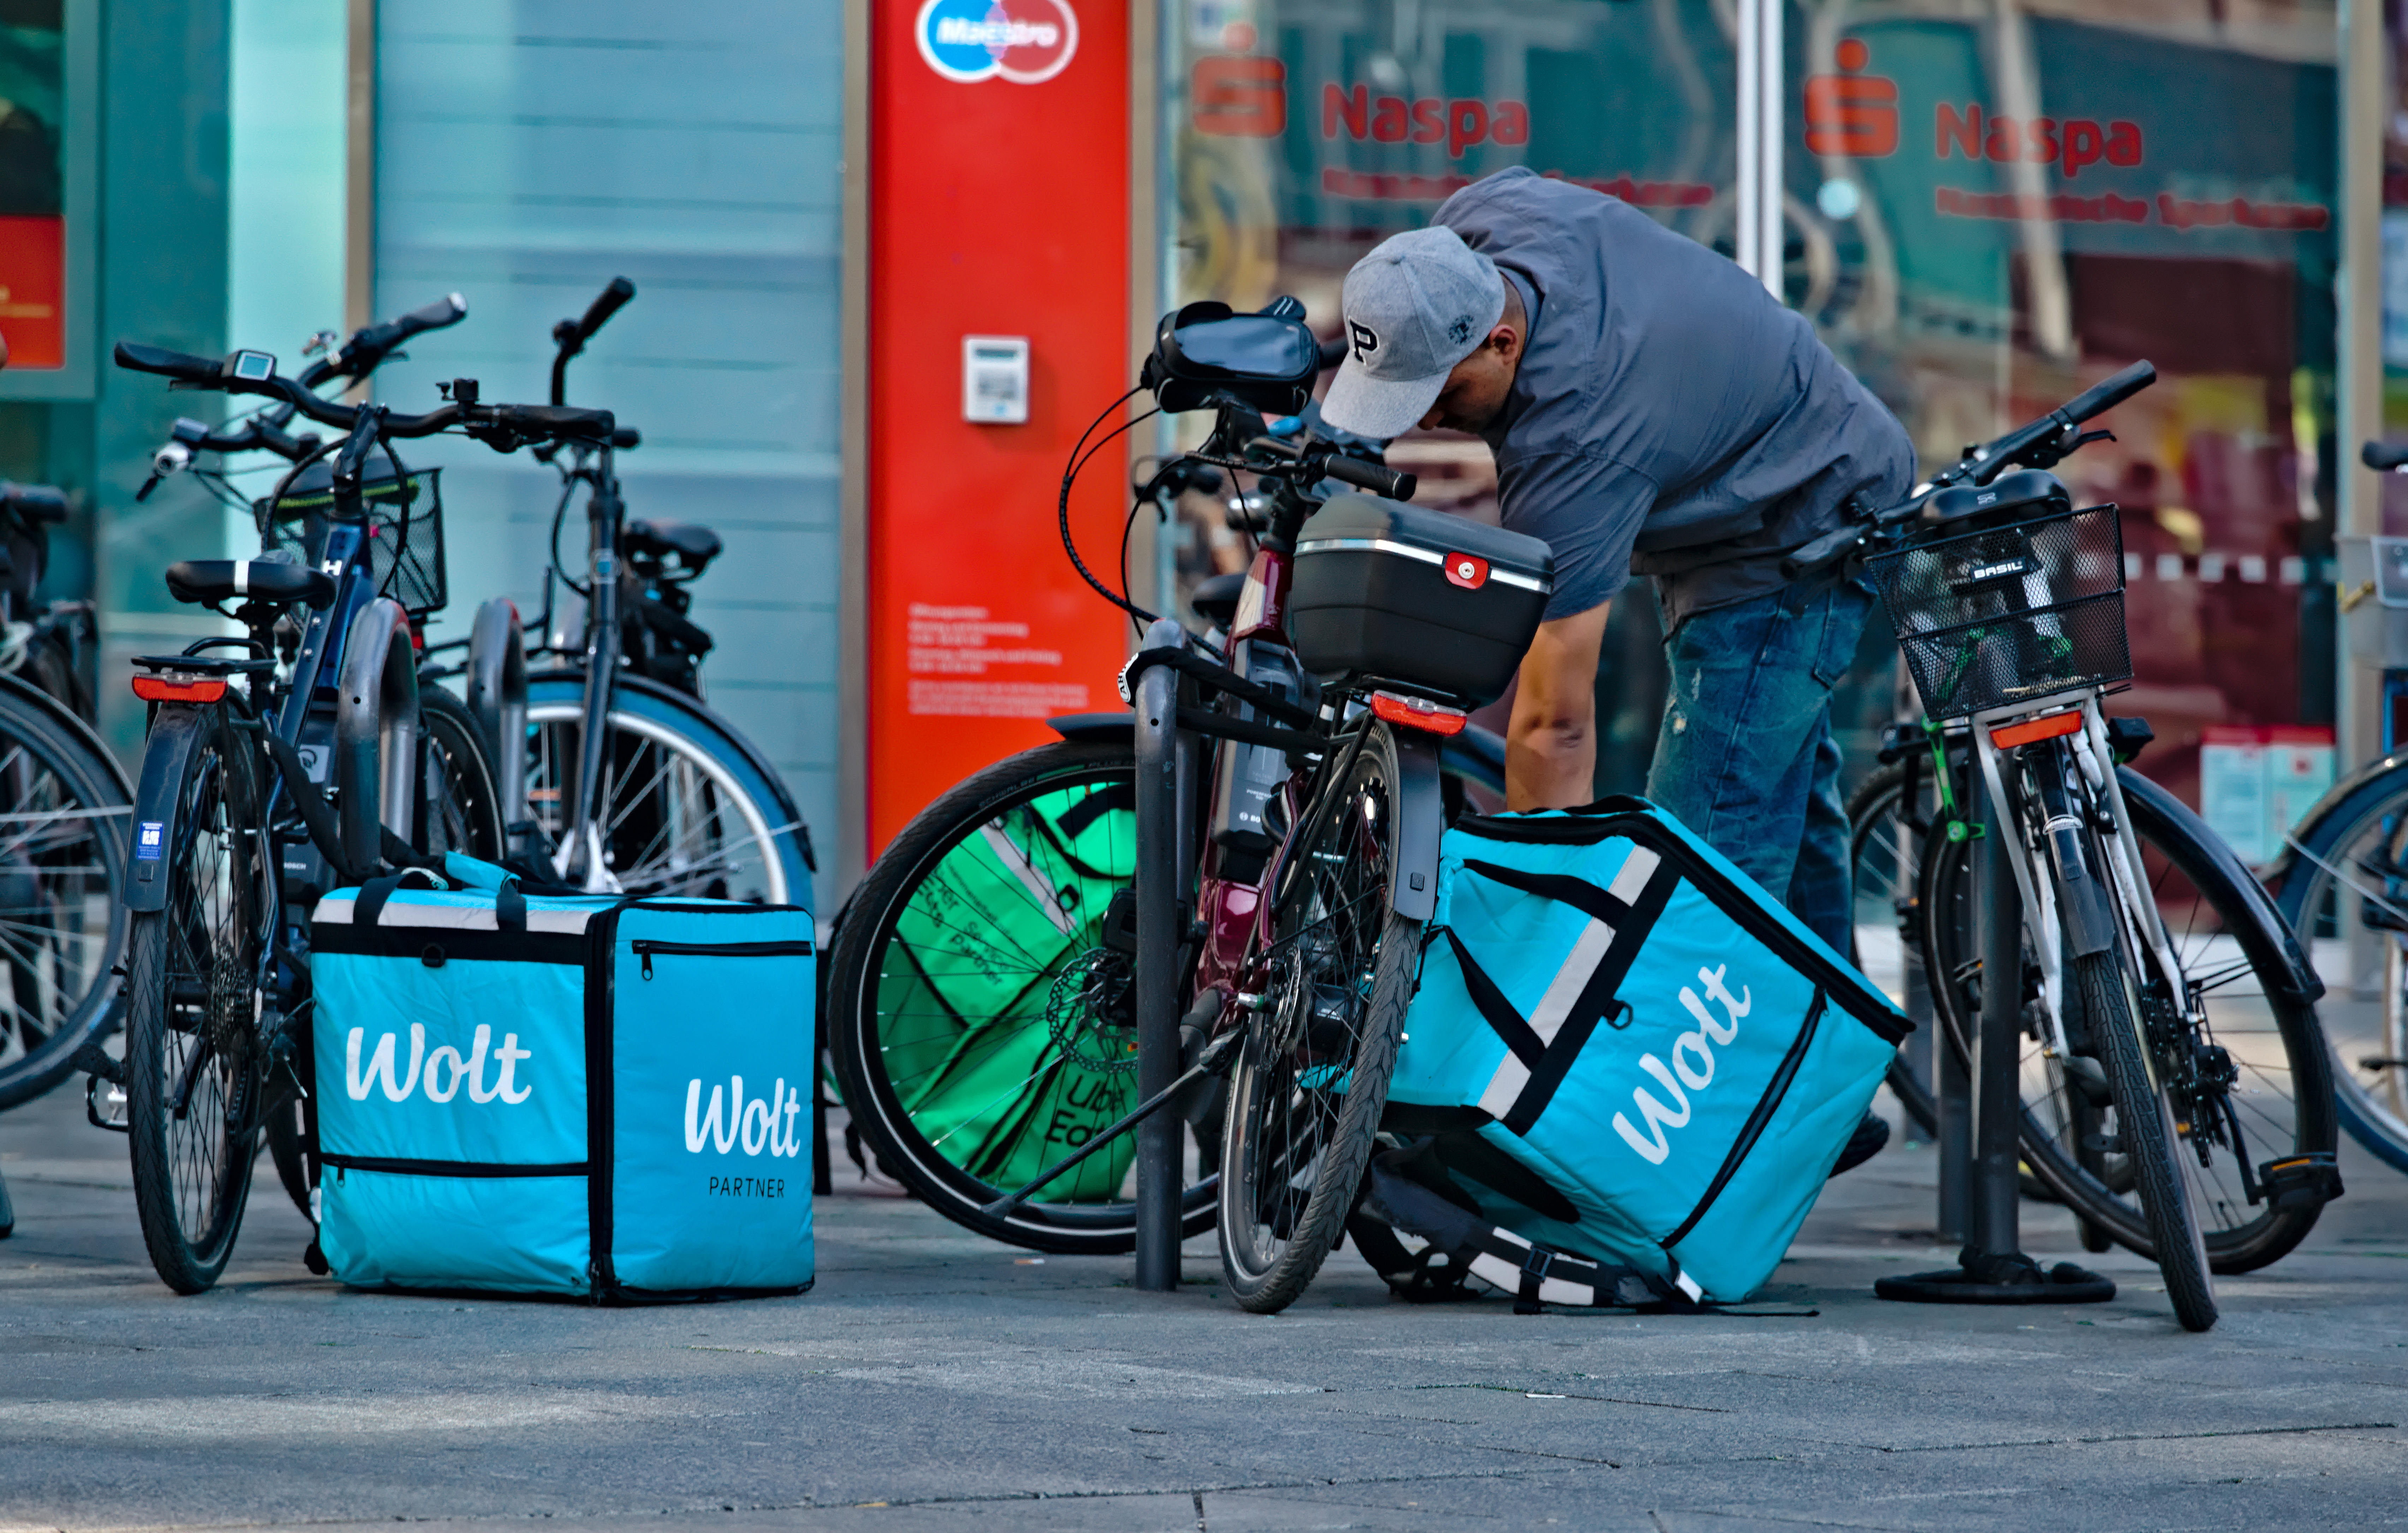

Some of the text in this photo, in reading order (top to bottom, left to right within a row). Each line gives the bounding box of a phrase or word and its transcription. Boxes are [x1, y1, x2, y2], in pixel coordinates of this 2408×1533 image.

[1323, 84, 1528, 158] Naspa
[1936, 103, 2142, 177] Naspa
[1348, 315, 1380, 366] P
[1974, 562, 2023, 579] BASIL
[346, 1022, 532, 1104] Wolt
[1612, 963, 1752, 1165] Wolt
[684, 1075, 800, 1158] Wolt
[709, 1176, 785, 1198] PARTNER
